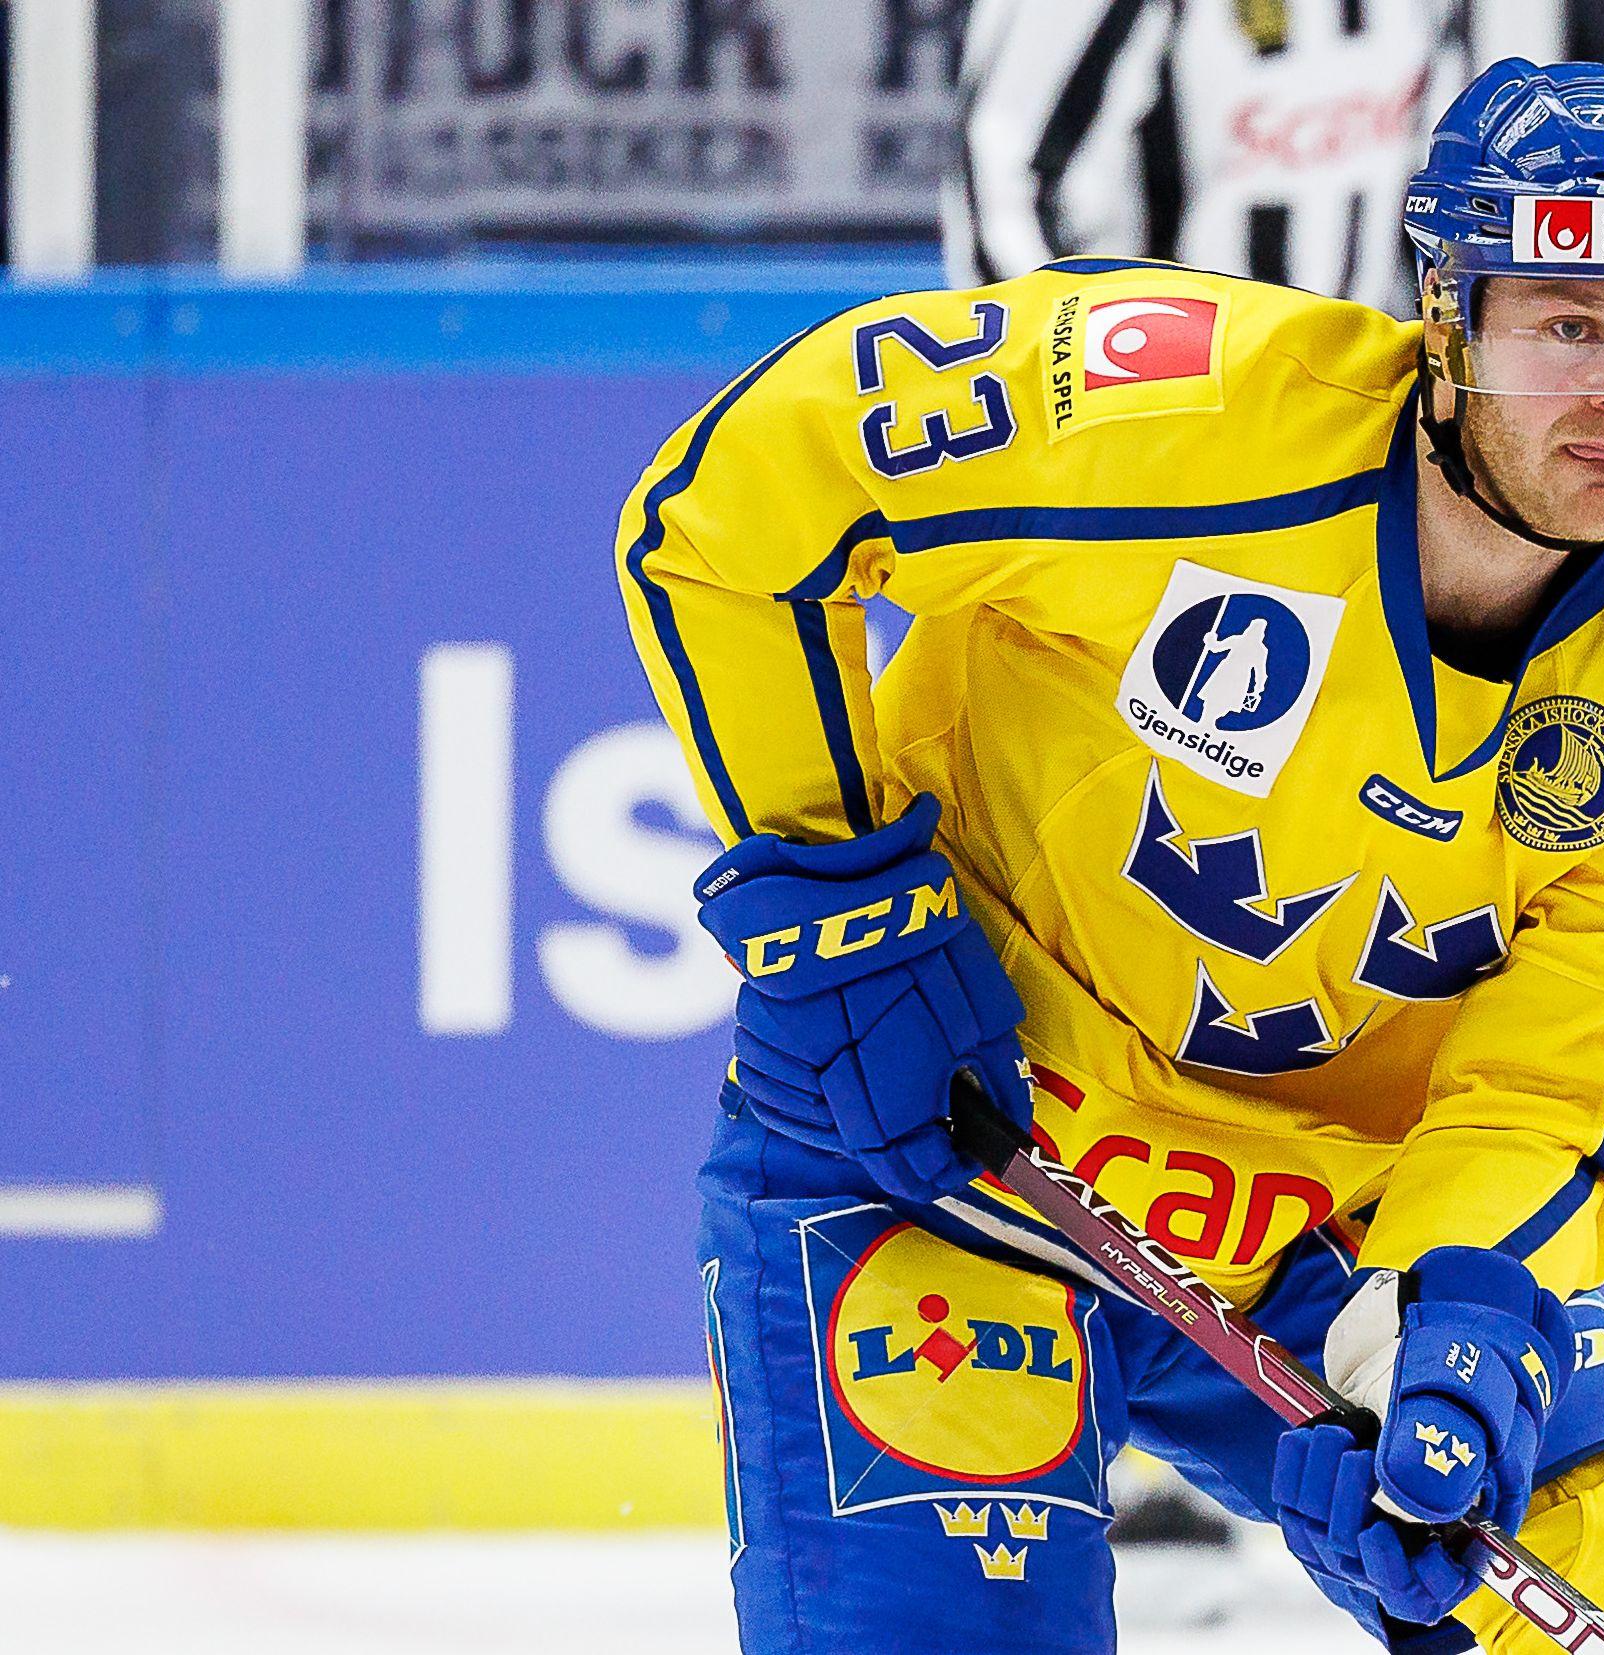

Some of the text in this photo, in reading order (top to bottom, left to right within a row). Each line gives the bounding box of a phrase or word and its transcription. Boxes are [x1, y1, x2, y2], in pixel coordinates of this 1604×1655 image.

[1405, 195, 1438, 214] CCM
[851, 300, 1018, 481] 23
[1052, 296, 1080, 430] SVENSKA SPEL
[1128, 698, 1265, 778] Gjensidige
[1499, 716, 1544, 784] SVENSKA
[1366, 782, 1459, 835] CCM
[702, 867, 740, 898] SWEDEN
[740, 877, 960, 978] CCM
[1029, 1146, 1236, 1336] VAPOR
[1100, 1241, 1199, 1326] HYPERLITE
[1445, 1341, 1461, 1368] PRO
